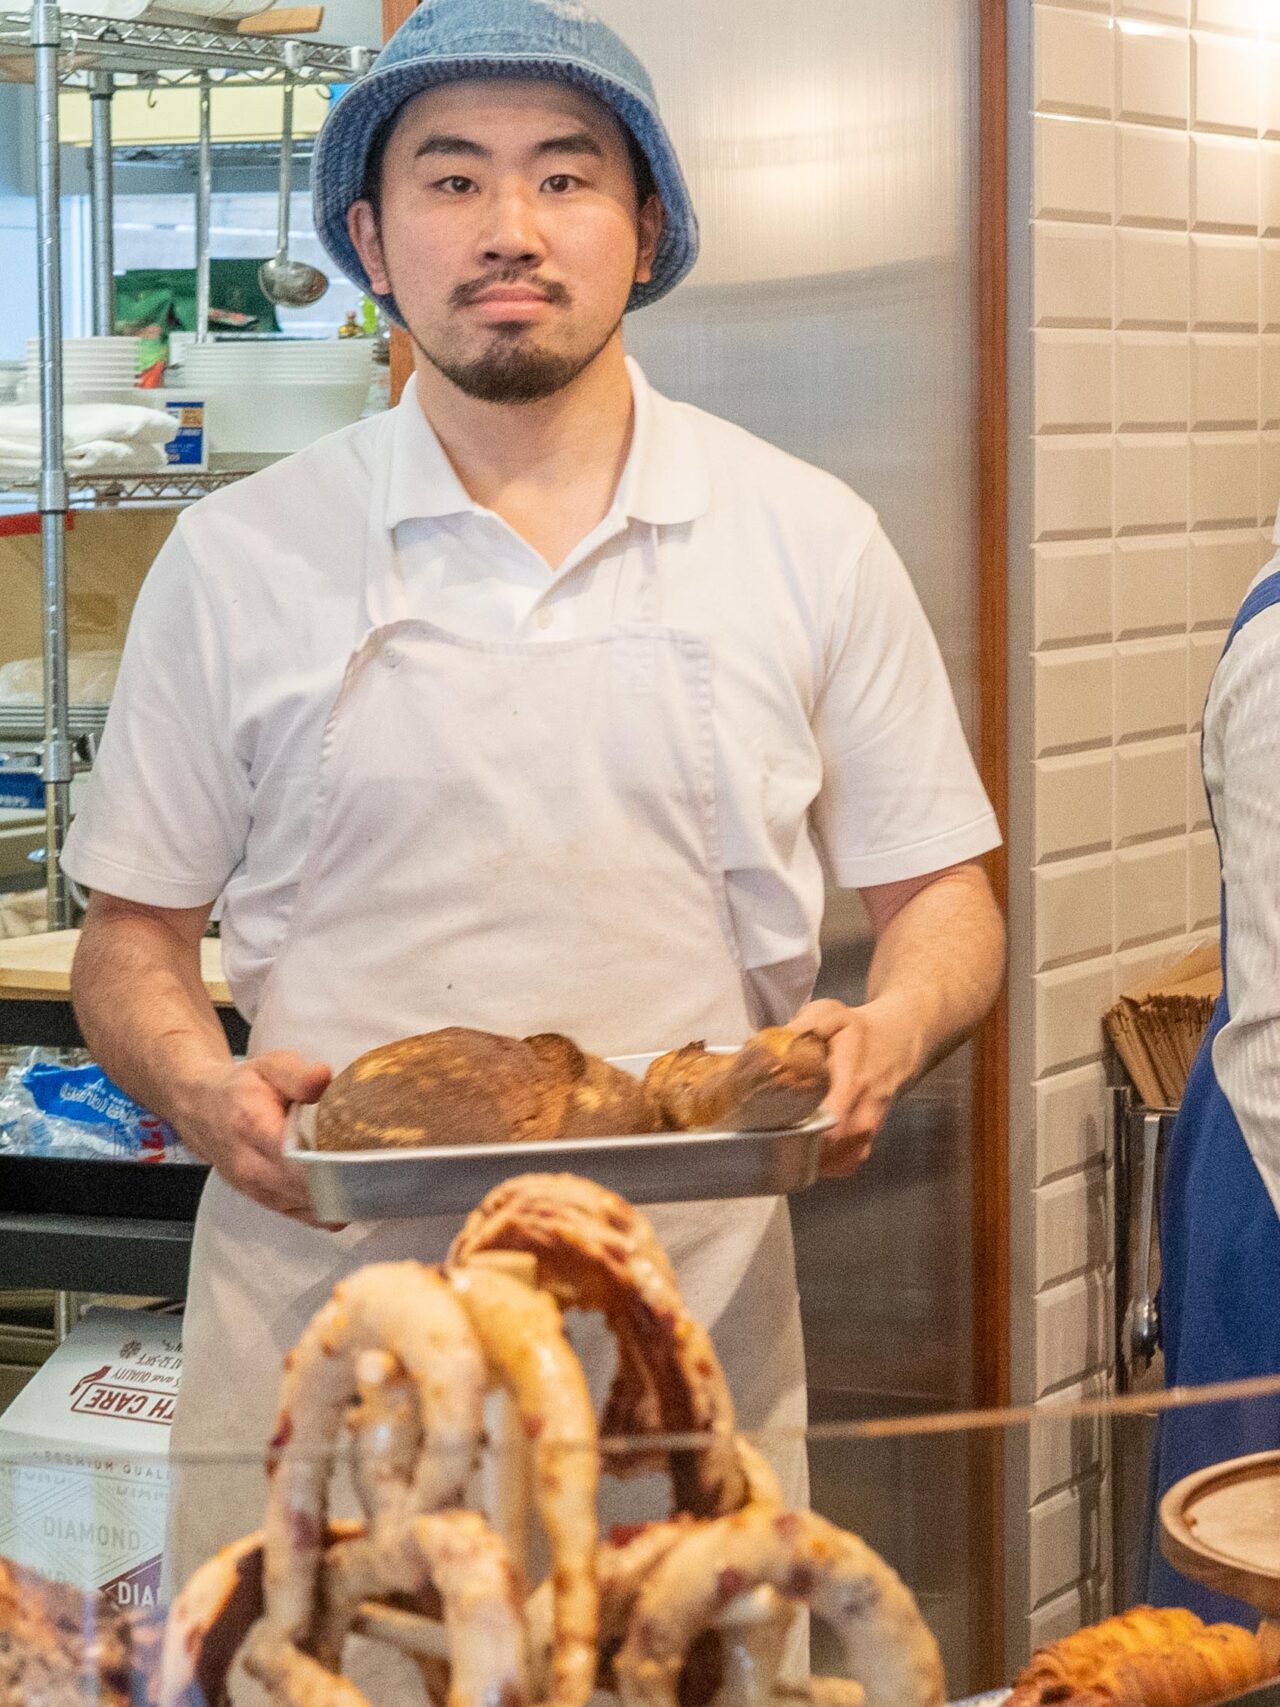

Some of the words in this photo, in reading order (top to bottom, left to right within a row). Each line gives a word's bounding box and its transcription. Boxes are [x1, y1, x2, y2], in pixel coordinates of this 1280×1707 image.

[112, 1367, 151, 1384] QUALITY
[84, 1389, 149, 1414] CARE
[45, 1450, 114, 1472] PREMIUM
[43, 1516, 140, 1551] DIAMOND
